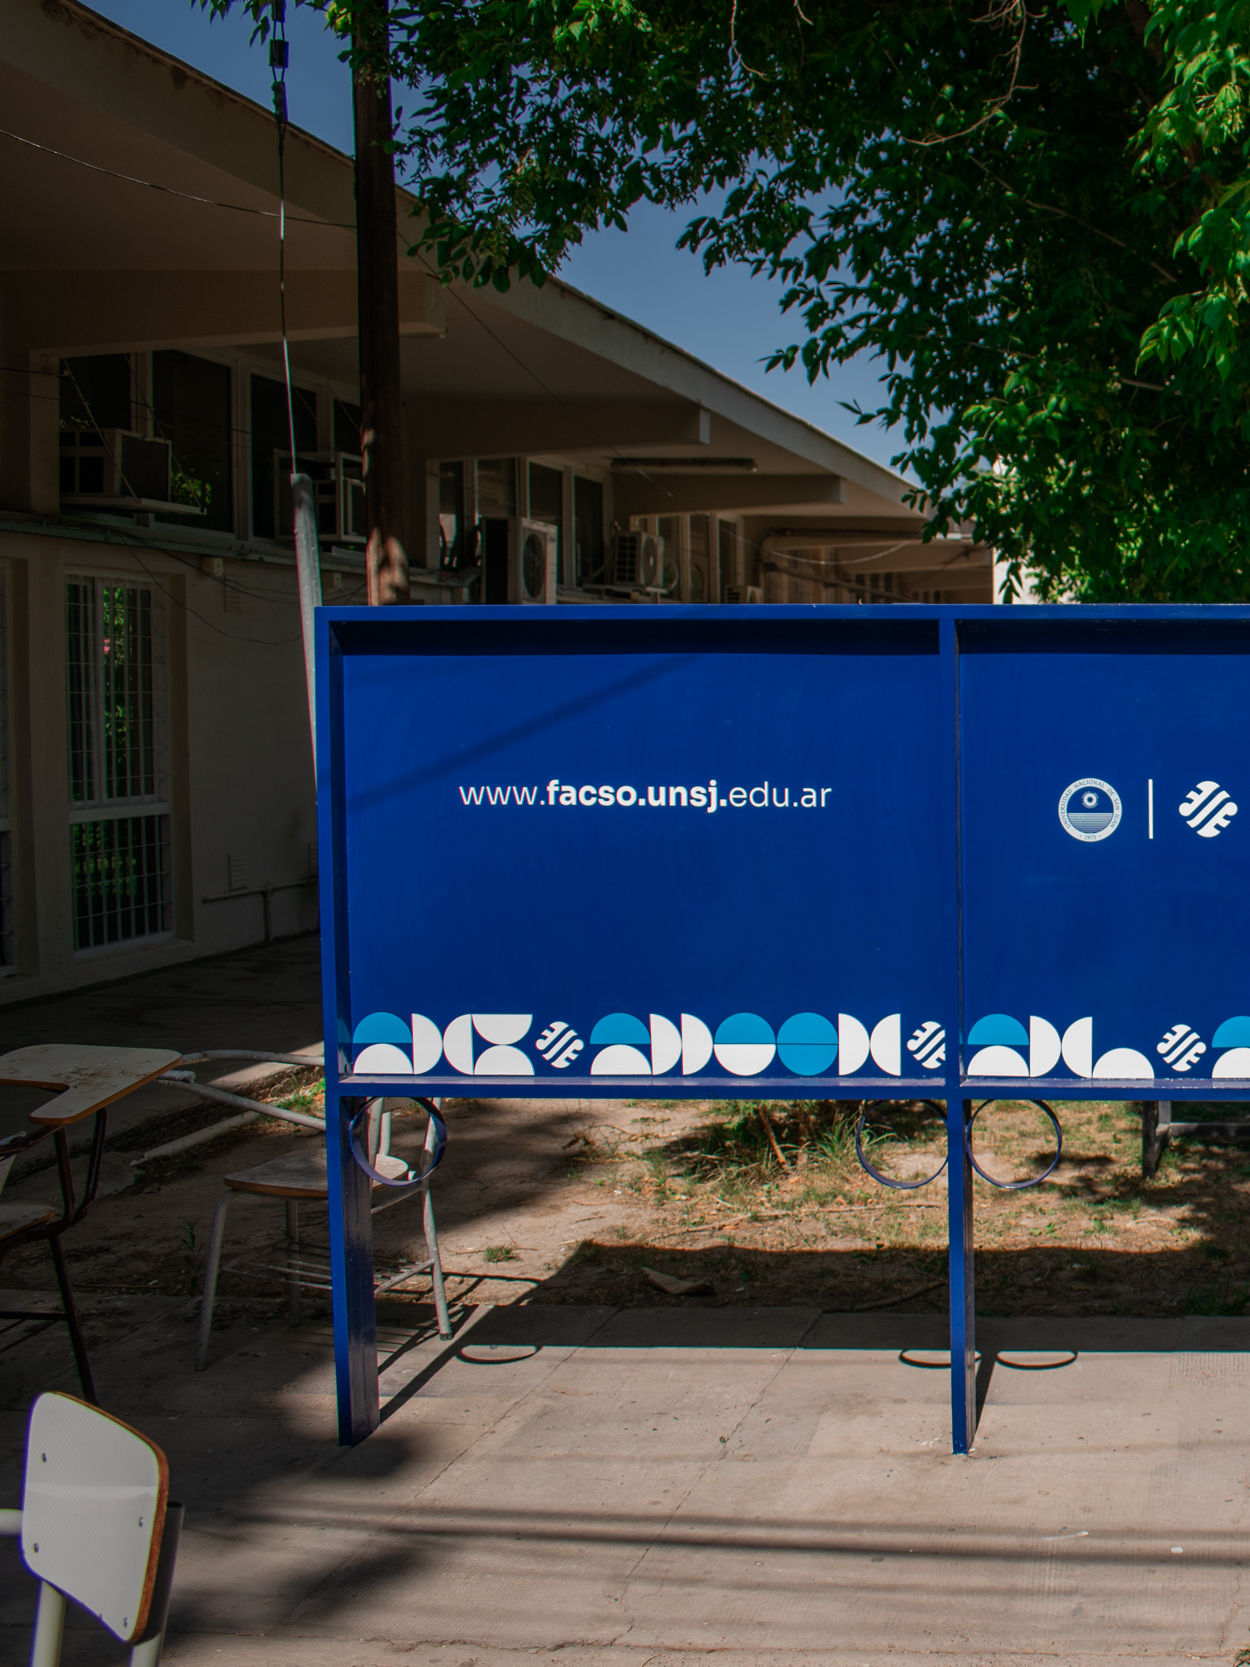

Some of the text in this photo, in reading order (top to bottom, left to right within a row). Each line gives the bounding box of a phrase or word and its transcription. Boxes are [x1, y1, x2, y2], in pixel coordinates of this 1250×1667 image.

[459, 779, 832, 813] www.facso.unsj.edu.ar
[1074, 779, 1105, 788] NACIONAL
[1107, 788, 1115, 796] DE
